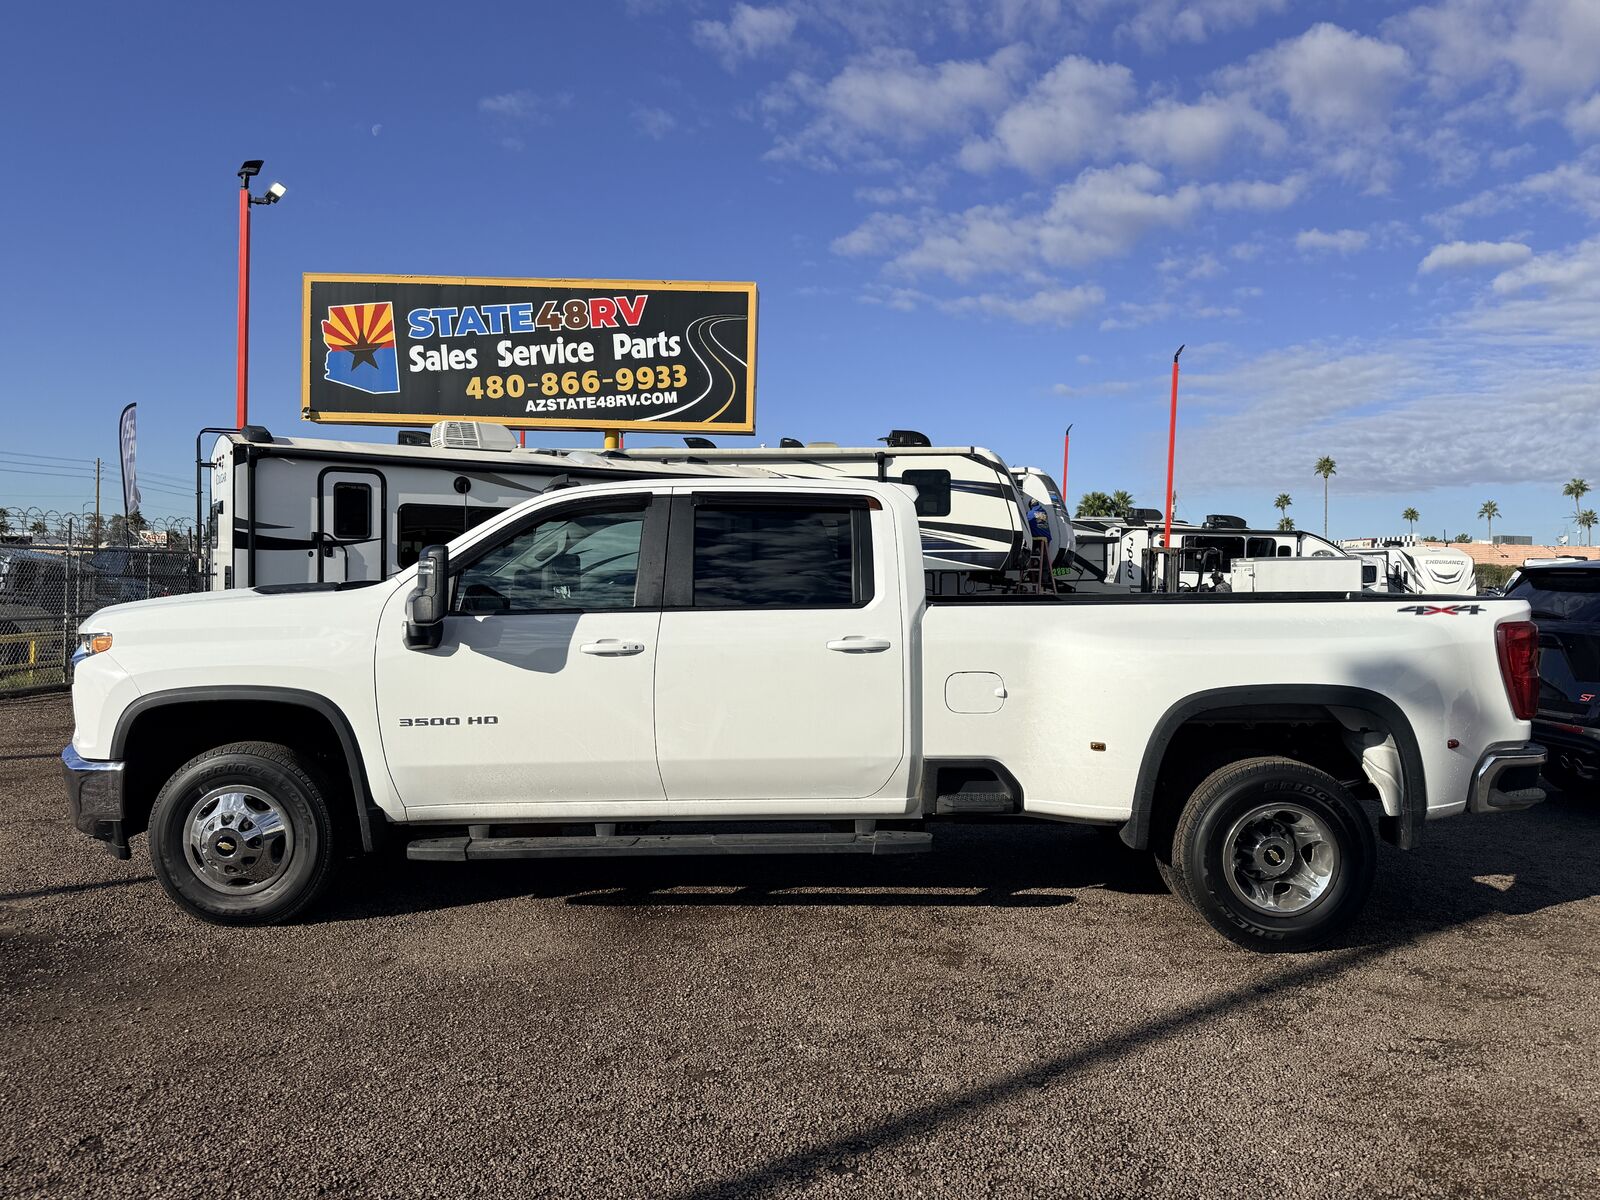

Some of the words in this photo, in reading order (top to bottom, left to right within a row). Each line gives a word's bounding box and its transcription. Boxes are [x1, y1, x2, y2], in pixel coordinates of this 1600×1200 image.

[409, 344, 478, 372] Sales
[497, 336, 595, 368] Service
[612, 331, 681, 360] Parts
[465, 364, 688, 400] 480-866-9933
[525, 391, 678, 412] AZSTATE48RV.COM
[1579, 693, 1596, 702] ST
[399, 717, 460, 727] 3500
[468, 716, 499, 725] HD
